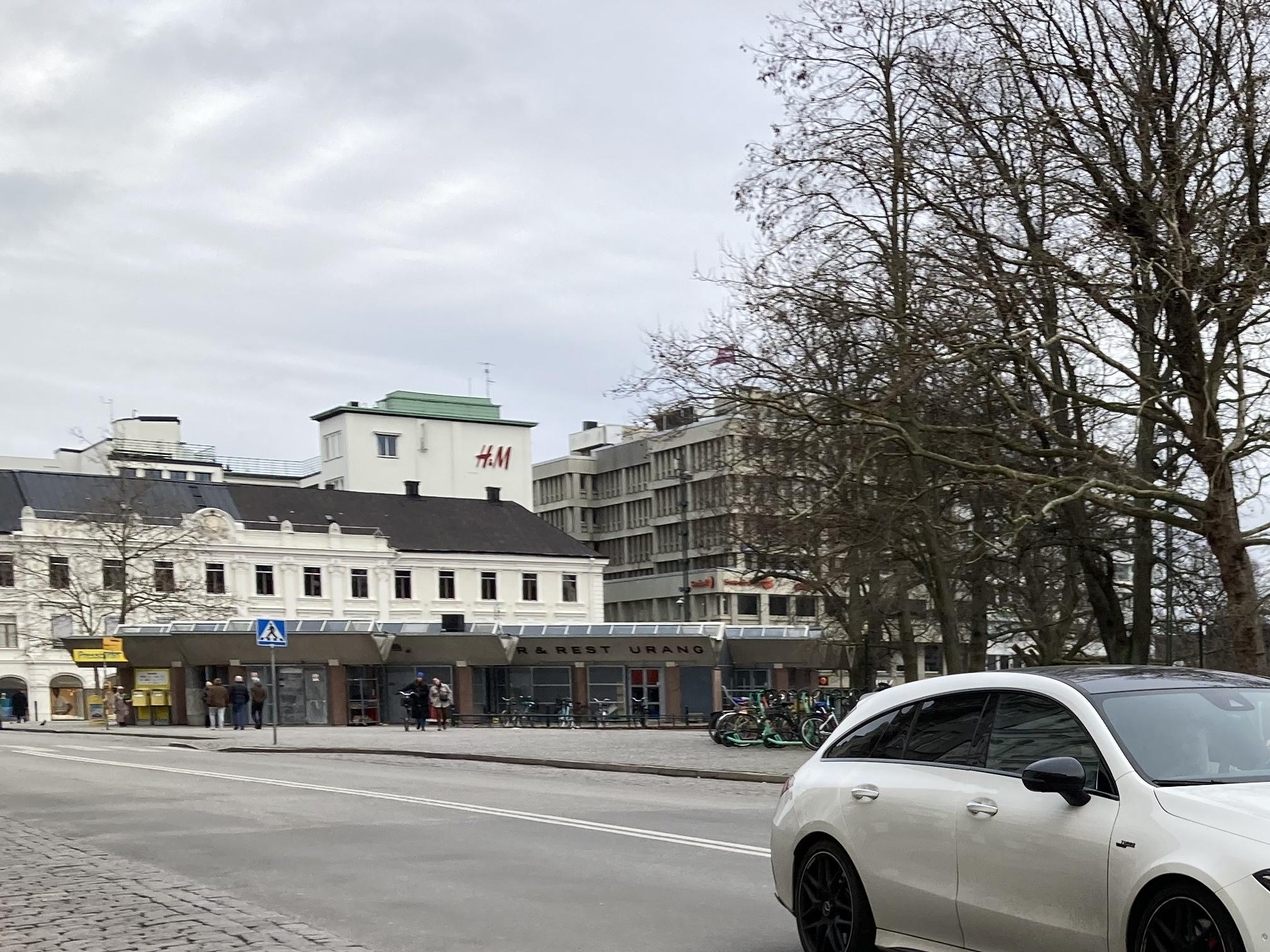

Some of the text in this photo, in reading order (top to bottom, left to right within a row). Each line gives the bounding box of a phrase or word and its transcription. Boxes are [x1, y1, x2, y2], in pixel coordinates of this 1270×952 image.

[475, 444, 512, 470] H&M
[535, 646, 547, 654] &
[556, 645, 612, 655] REST
[629, 645, 704, 655] URANG
